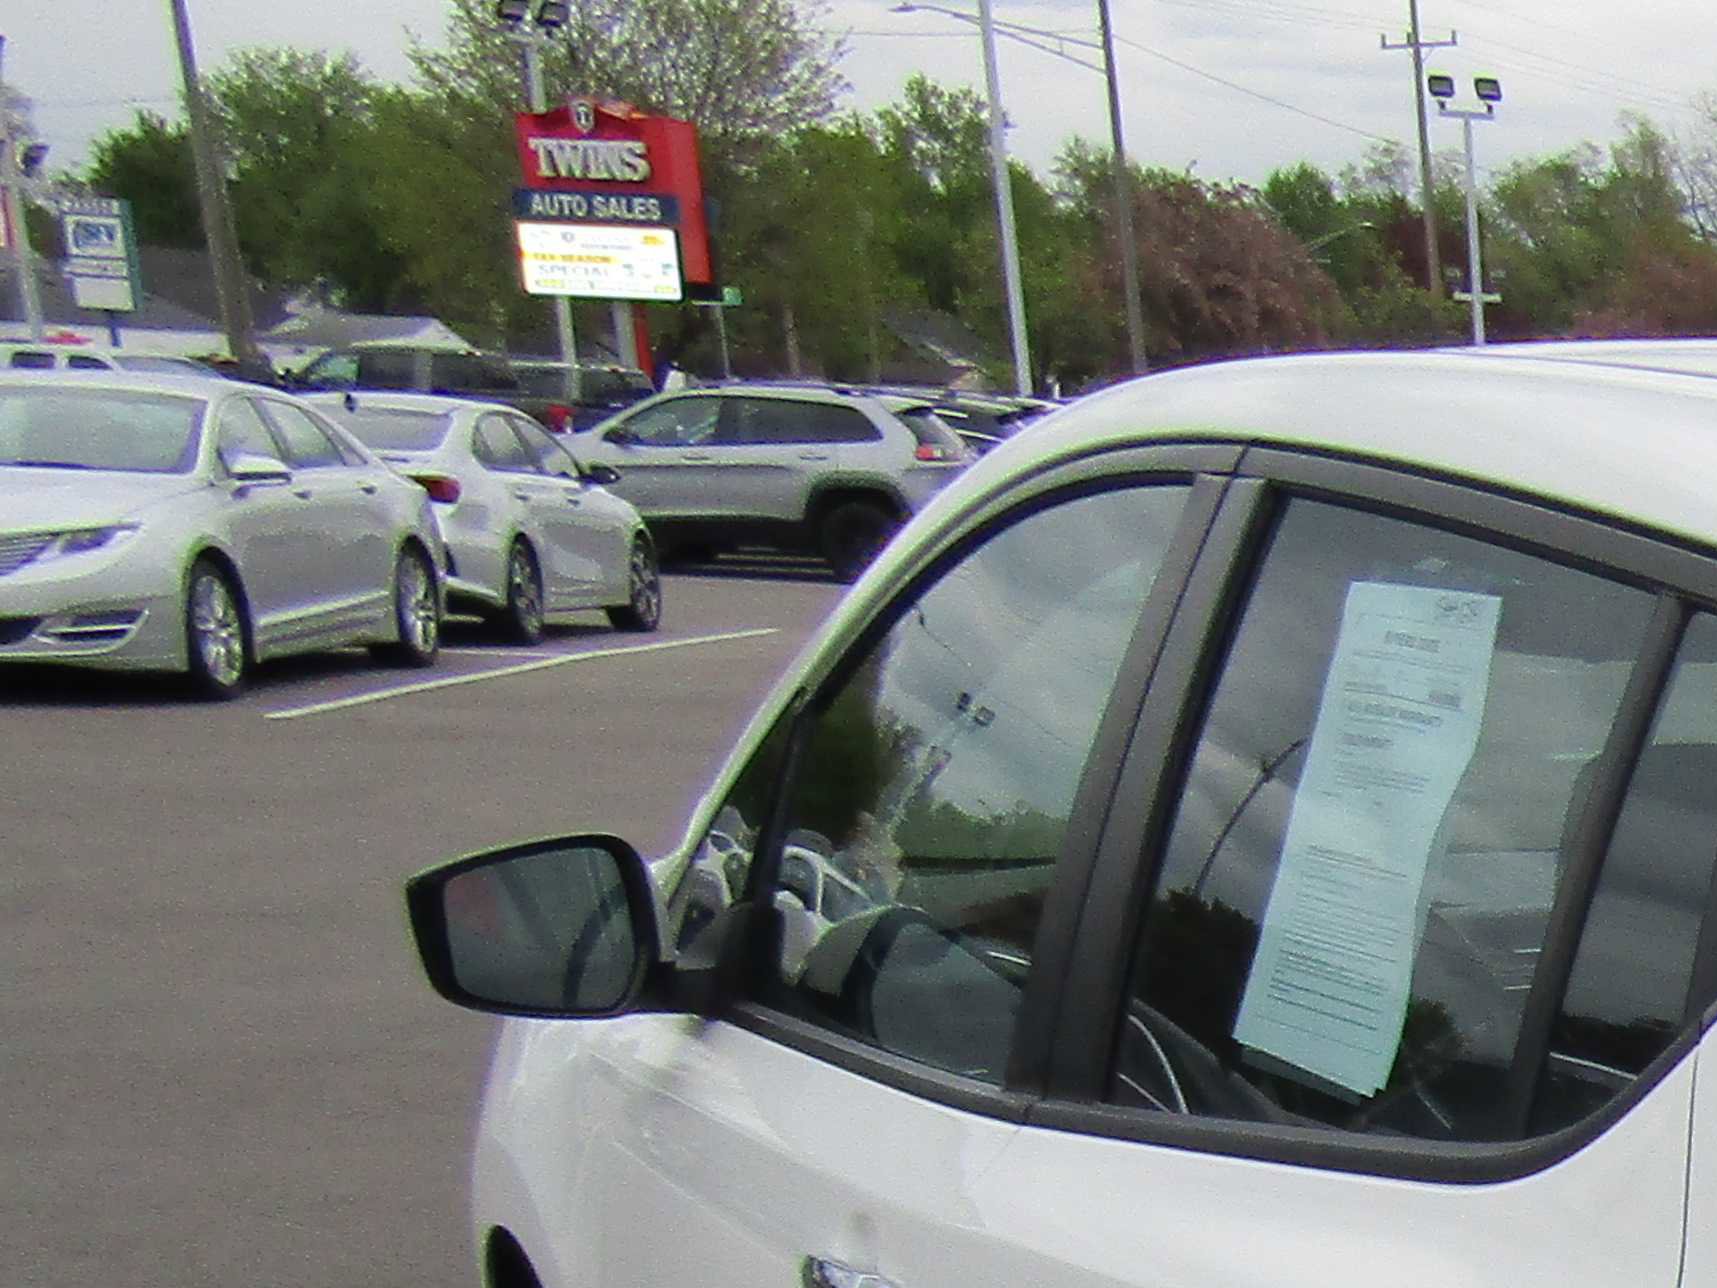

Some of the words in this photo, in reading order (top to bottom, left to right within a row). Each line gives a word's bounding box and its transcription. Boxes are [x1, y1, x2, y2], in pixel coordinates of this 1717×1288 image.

[528, 137, 652, 181] TWINS
[531, 194, 587, 217] AUTO
[593, 195, 661, 220] SALES
